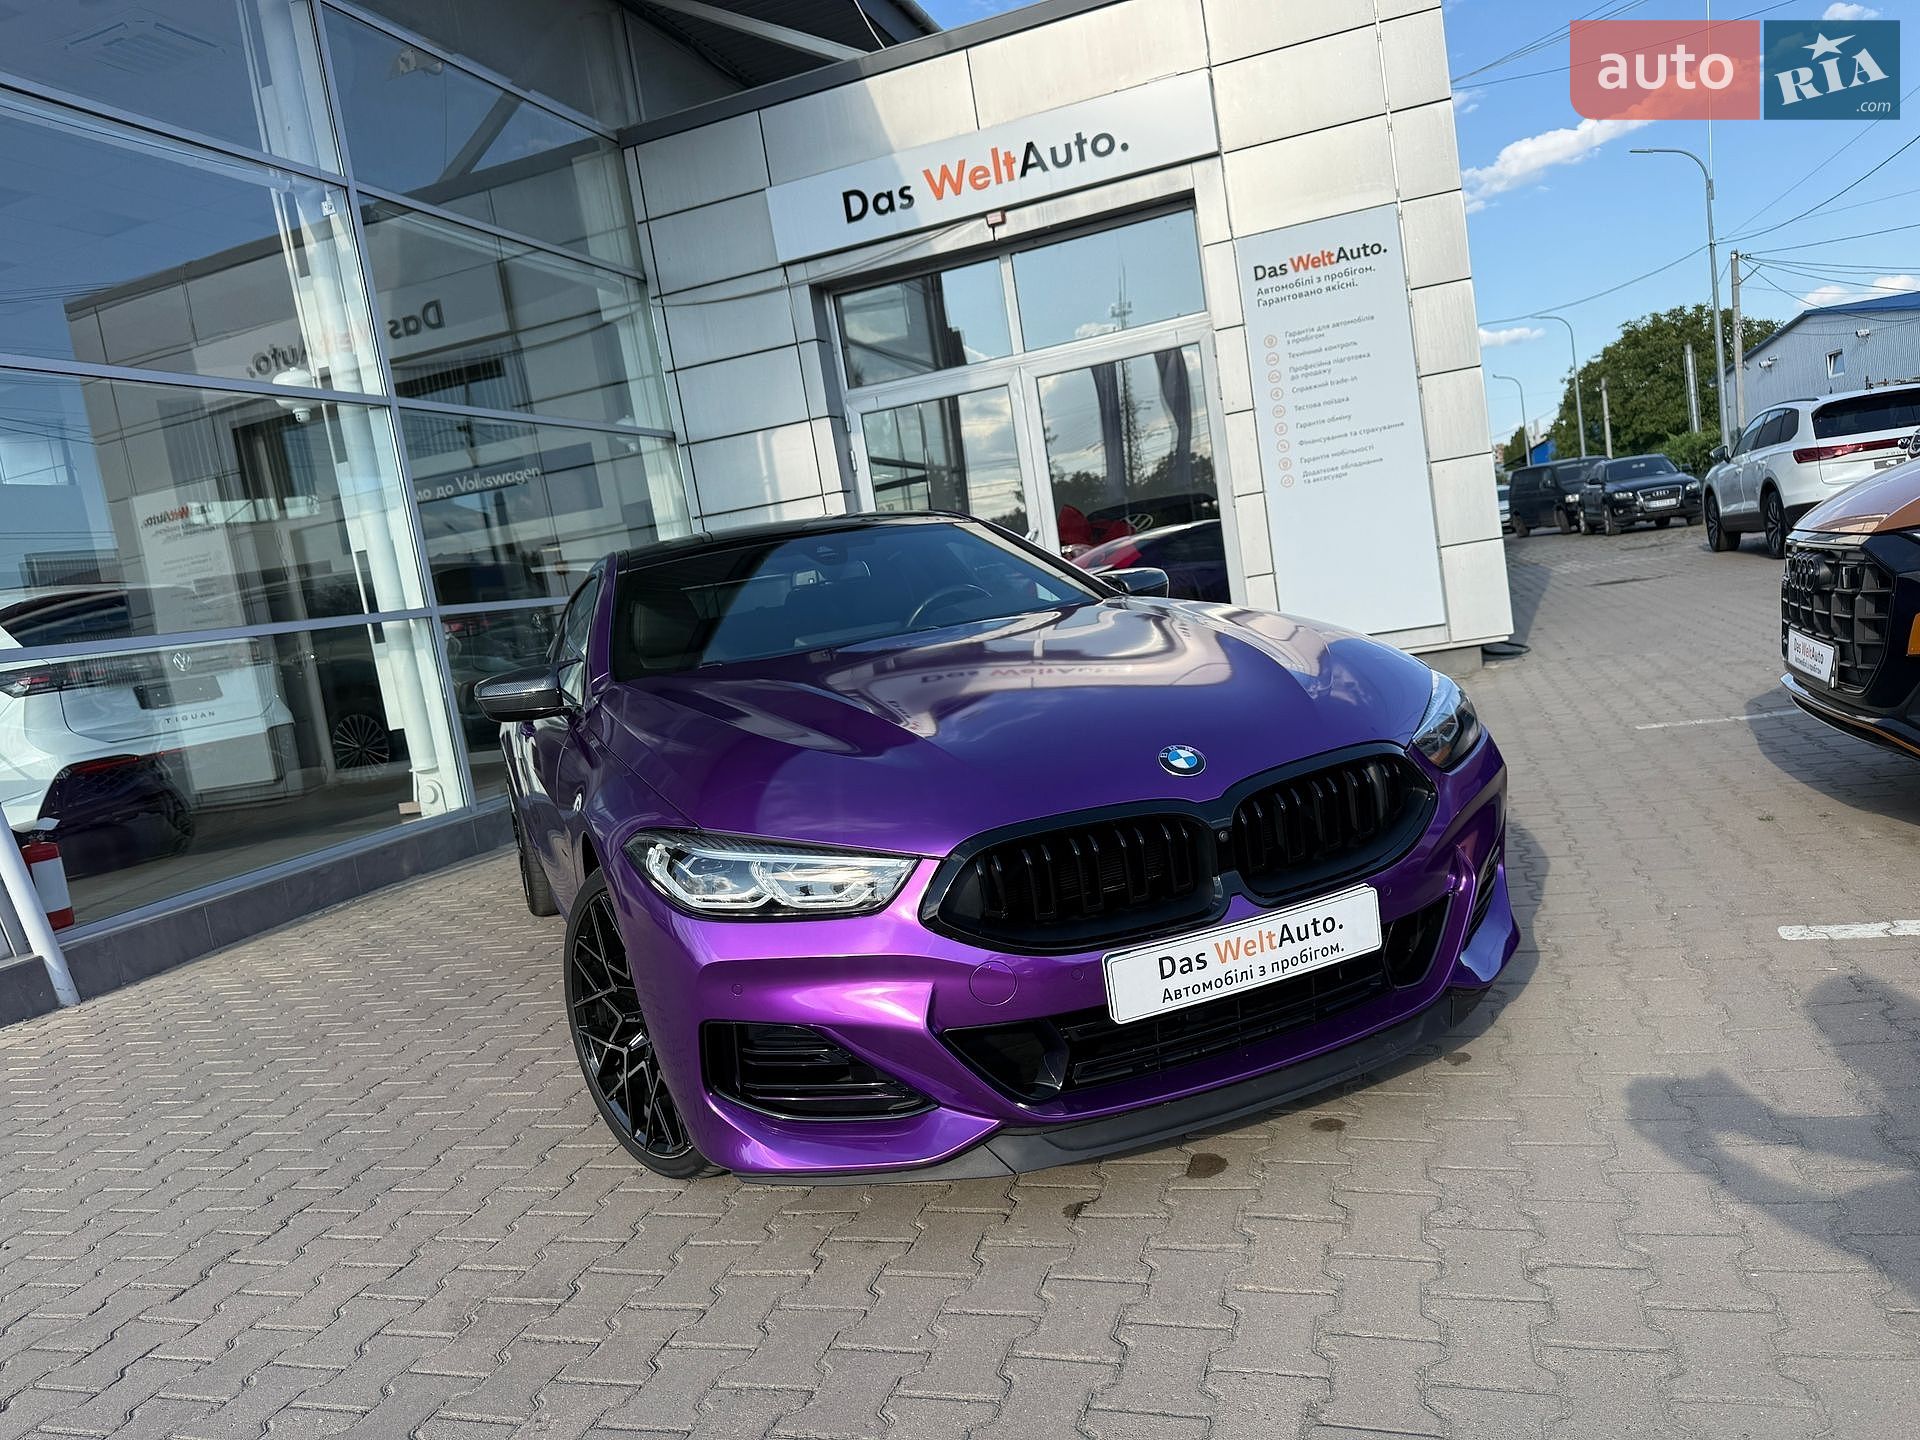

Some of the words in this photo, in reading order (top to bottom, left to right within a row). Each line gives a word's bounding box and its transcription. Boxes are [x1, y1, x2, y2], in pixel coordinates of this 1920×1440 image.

[842, 184, 915, 224] Das
[922, 132, 1129, 201] WeltAuto.
[1253, 263, 1288, 281] Das
[1289, 242, 1388, 273] WeltAuto.
[1256, 276, 1314, 297] Автомобілі
[1316, 275, 1322, 283] з
[1324, 264, 1376, 283] пробігом.
[1257, 288, 1323, 308] Гарантовано
[165, 711, 215, 724] TIGUAN
[1158, 952, 1208, 980] Das
[1214, 916, 1344, 964] WeltAuto.
[1162, 965, 1254, 1003] Автомобілі
[1258, 966, 1266, 976] з
[1271, 942, 1344, 973] пробігом.
